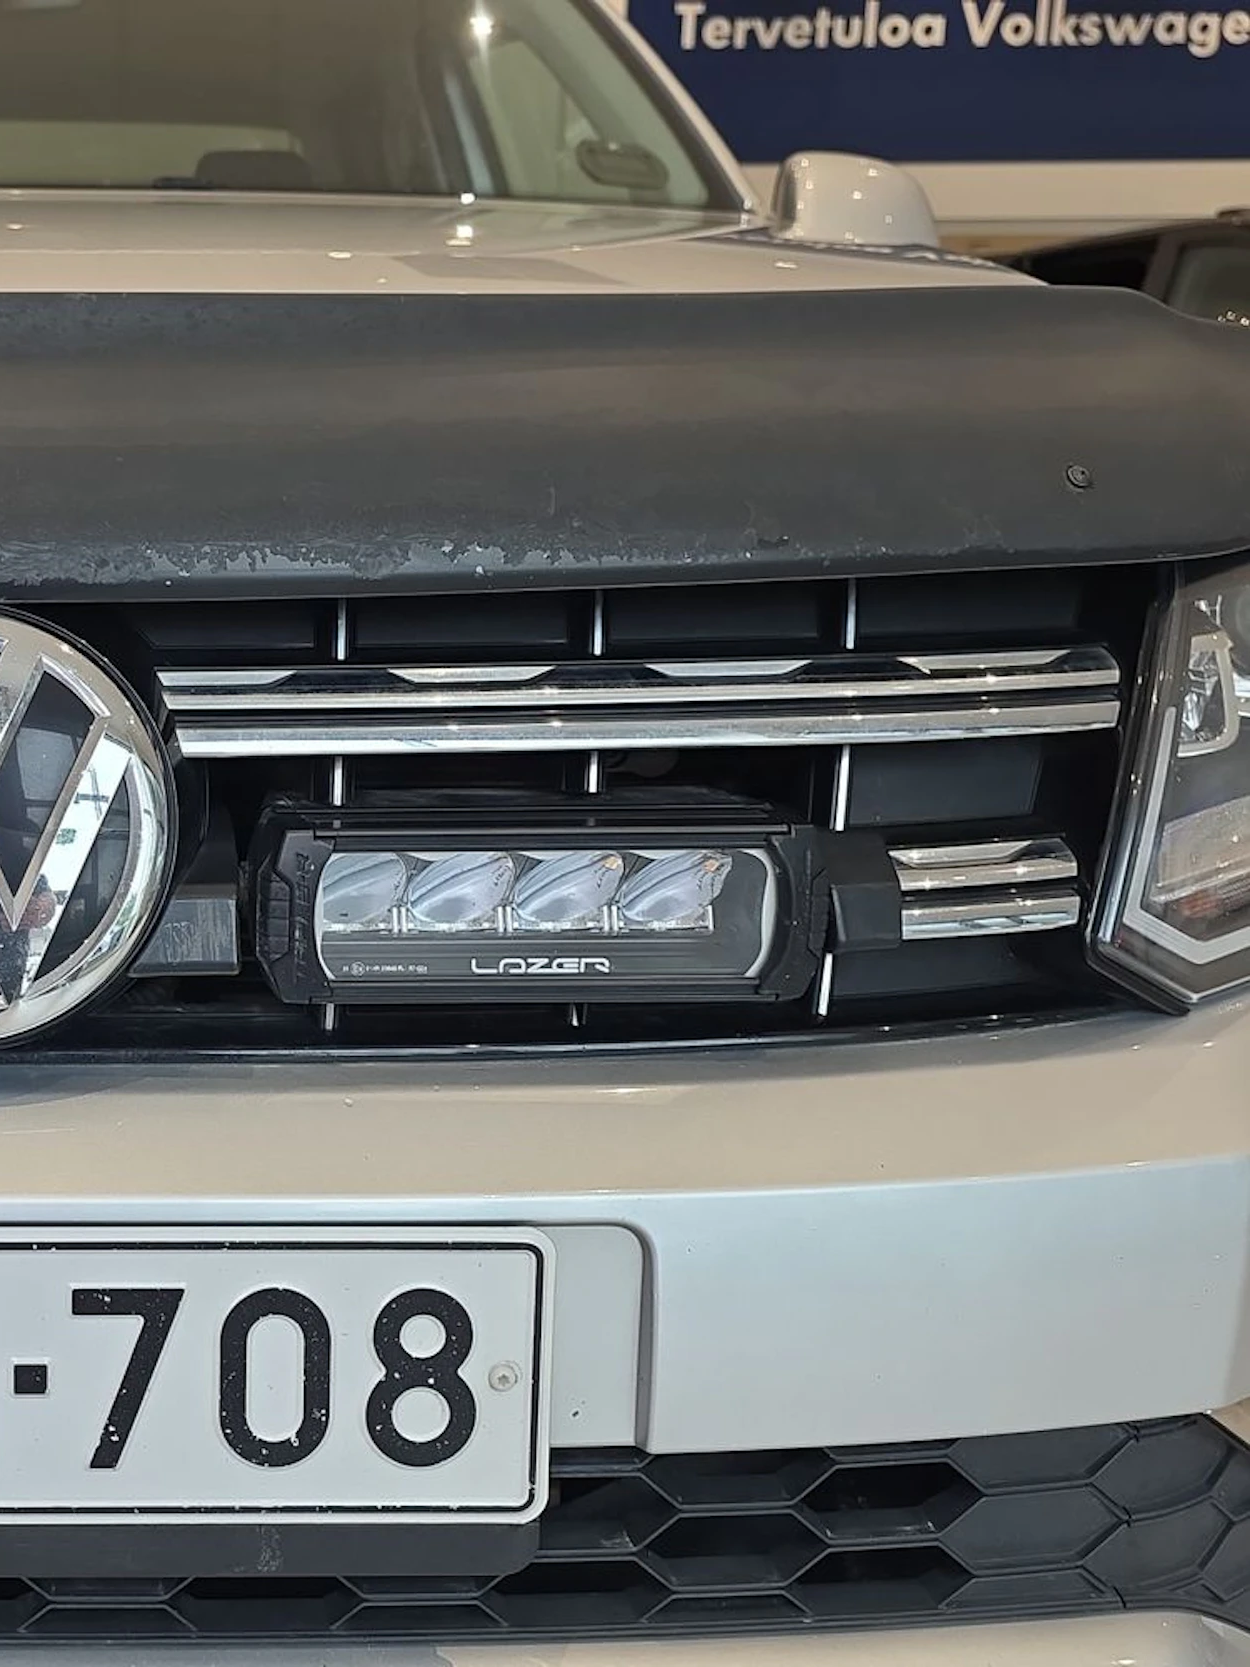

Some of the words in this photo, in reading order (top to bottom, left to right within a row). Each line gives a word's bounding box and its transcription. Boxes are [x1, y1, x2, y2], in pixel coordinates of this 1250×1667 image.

[675, 0, 947, 50] Tervetuloa
[963, 0, 1250, 57] Volkswage
[471, 958, 611, 974] LAZER
